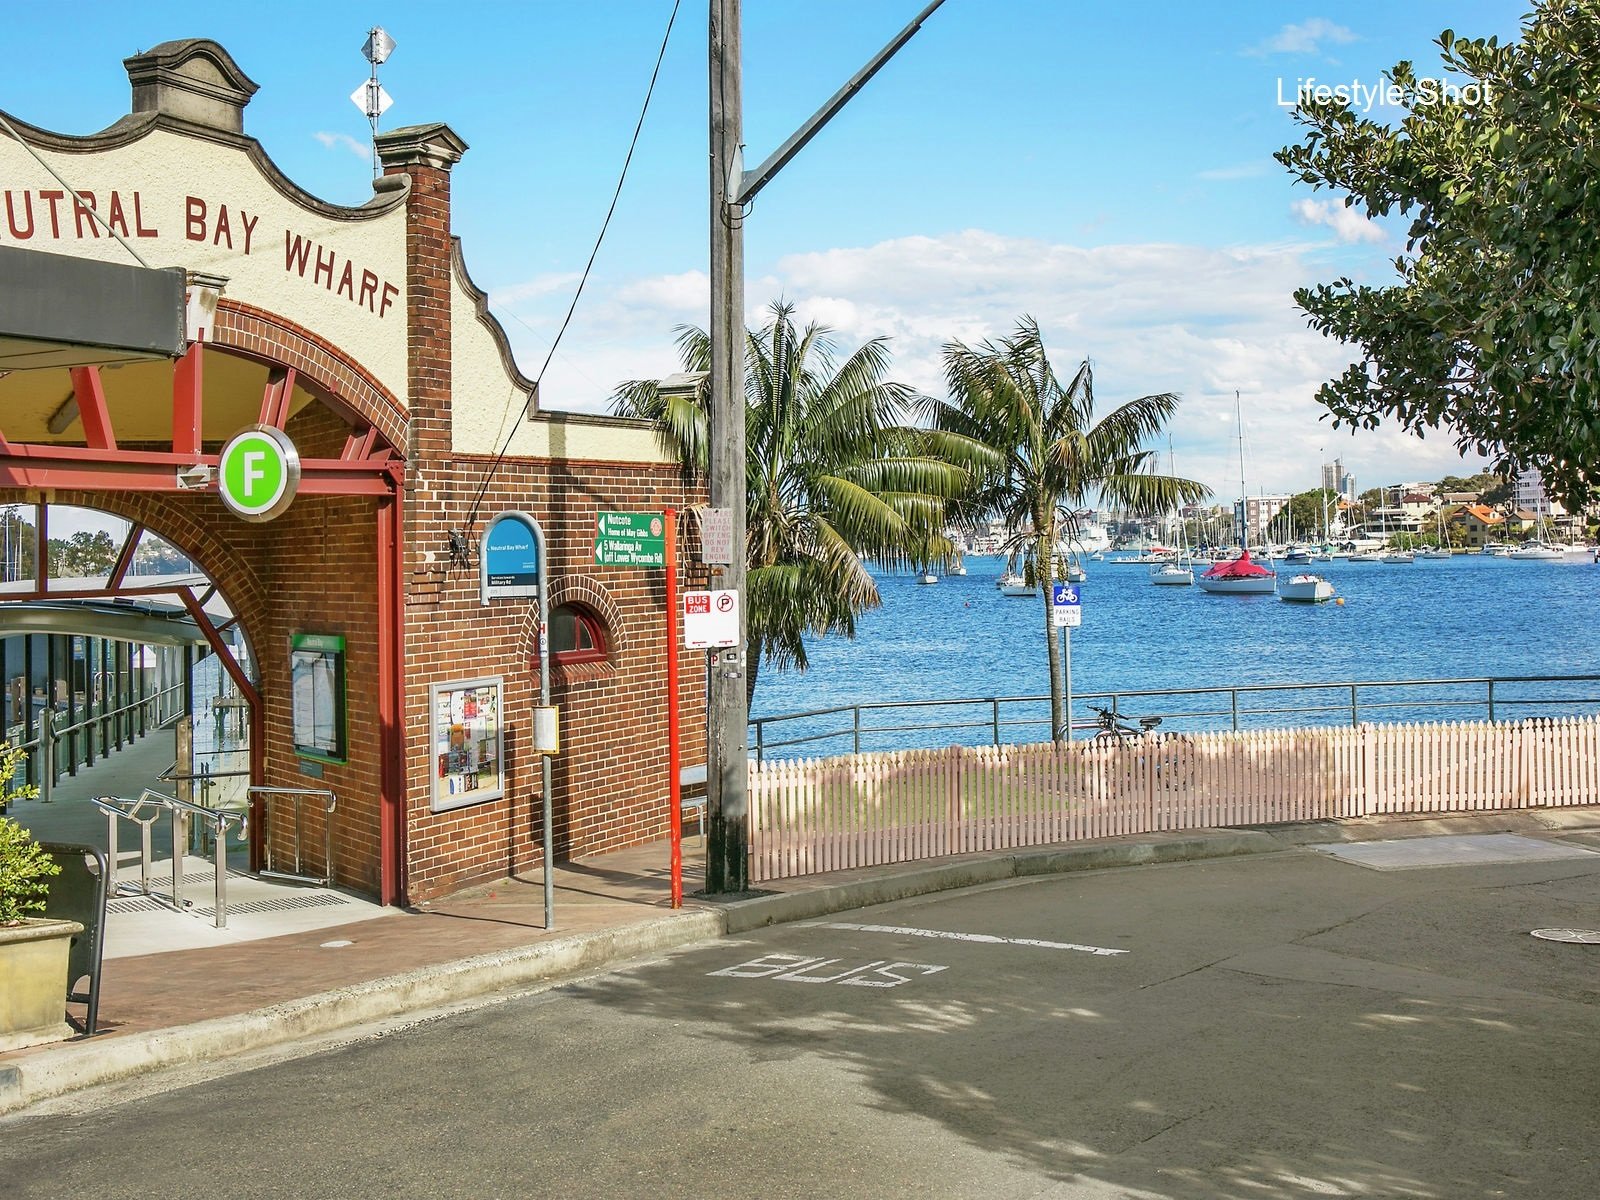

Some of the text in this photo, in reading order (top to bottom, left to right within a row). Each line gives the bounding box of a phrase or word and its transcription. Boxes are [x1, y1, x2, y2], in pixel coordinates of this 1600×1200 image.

[0, 189, 400, 318] UTRAL BAY WHARF
[243, 451, 265, 497] F
[608, 514, 632, 526] Nutcote
[607, 528, 649, 539] Home of May Gibbs
[603, 540, 609, 551] 5
[635, 541, 642, 551] Av
[604, 552, 613, 563] (off
[614, 552, 630, 563] Lower
[630, 552, 654, 565] Wycombe
[687, 596, 708, 605] BUS
[689, 605, 708, 613] ZONE
[704, 953, 950, 988] BUS
